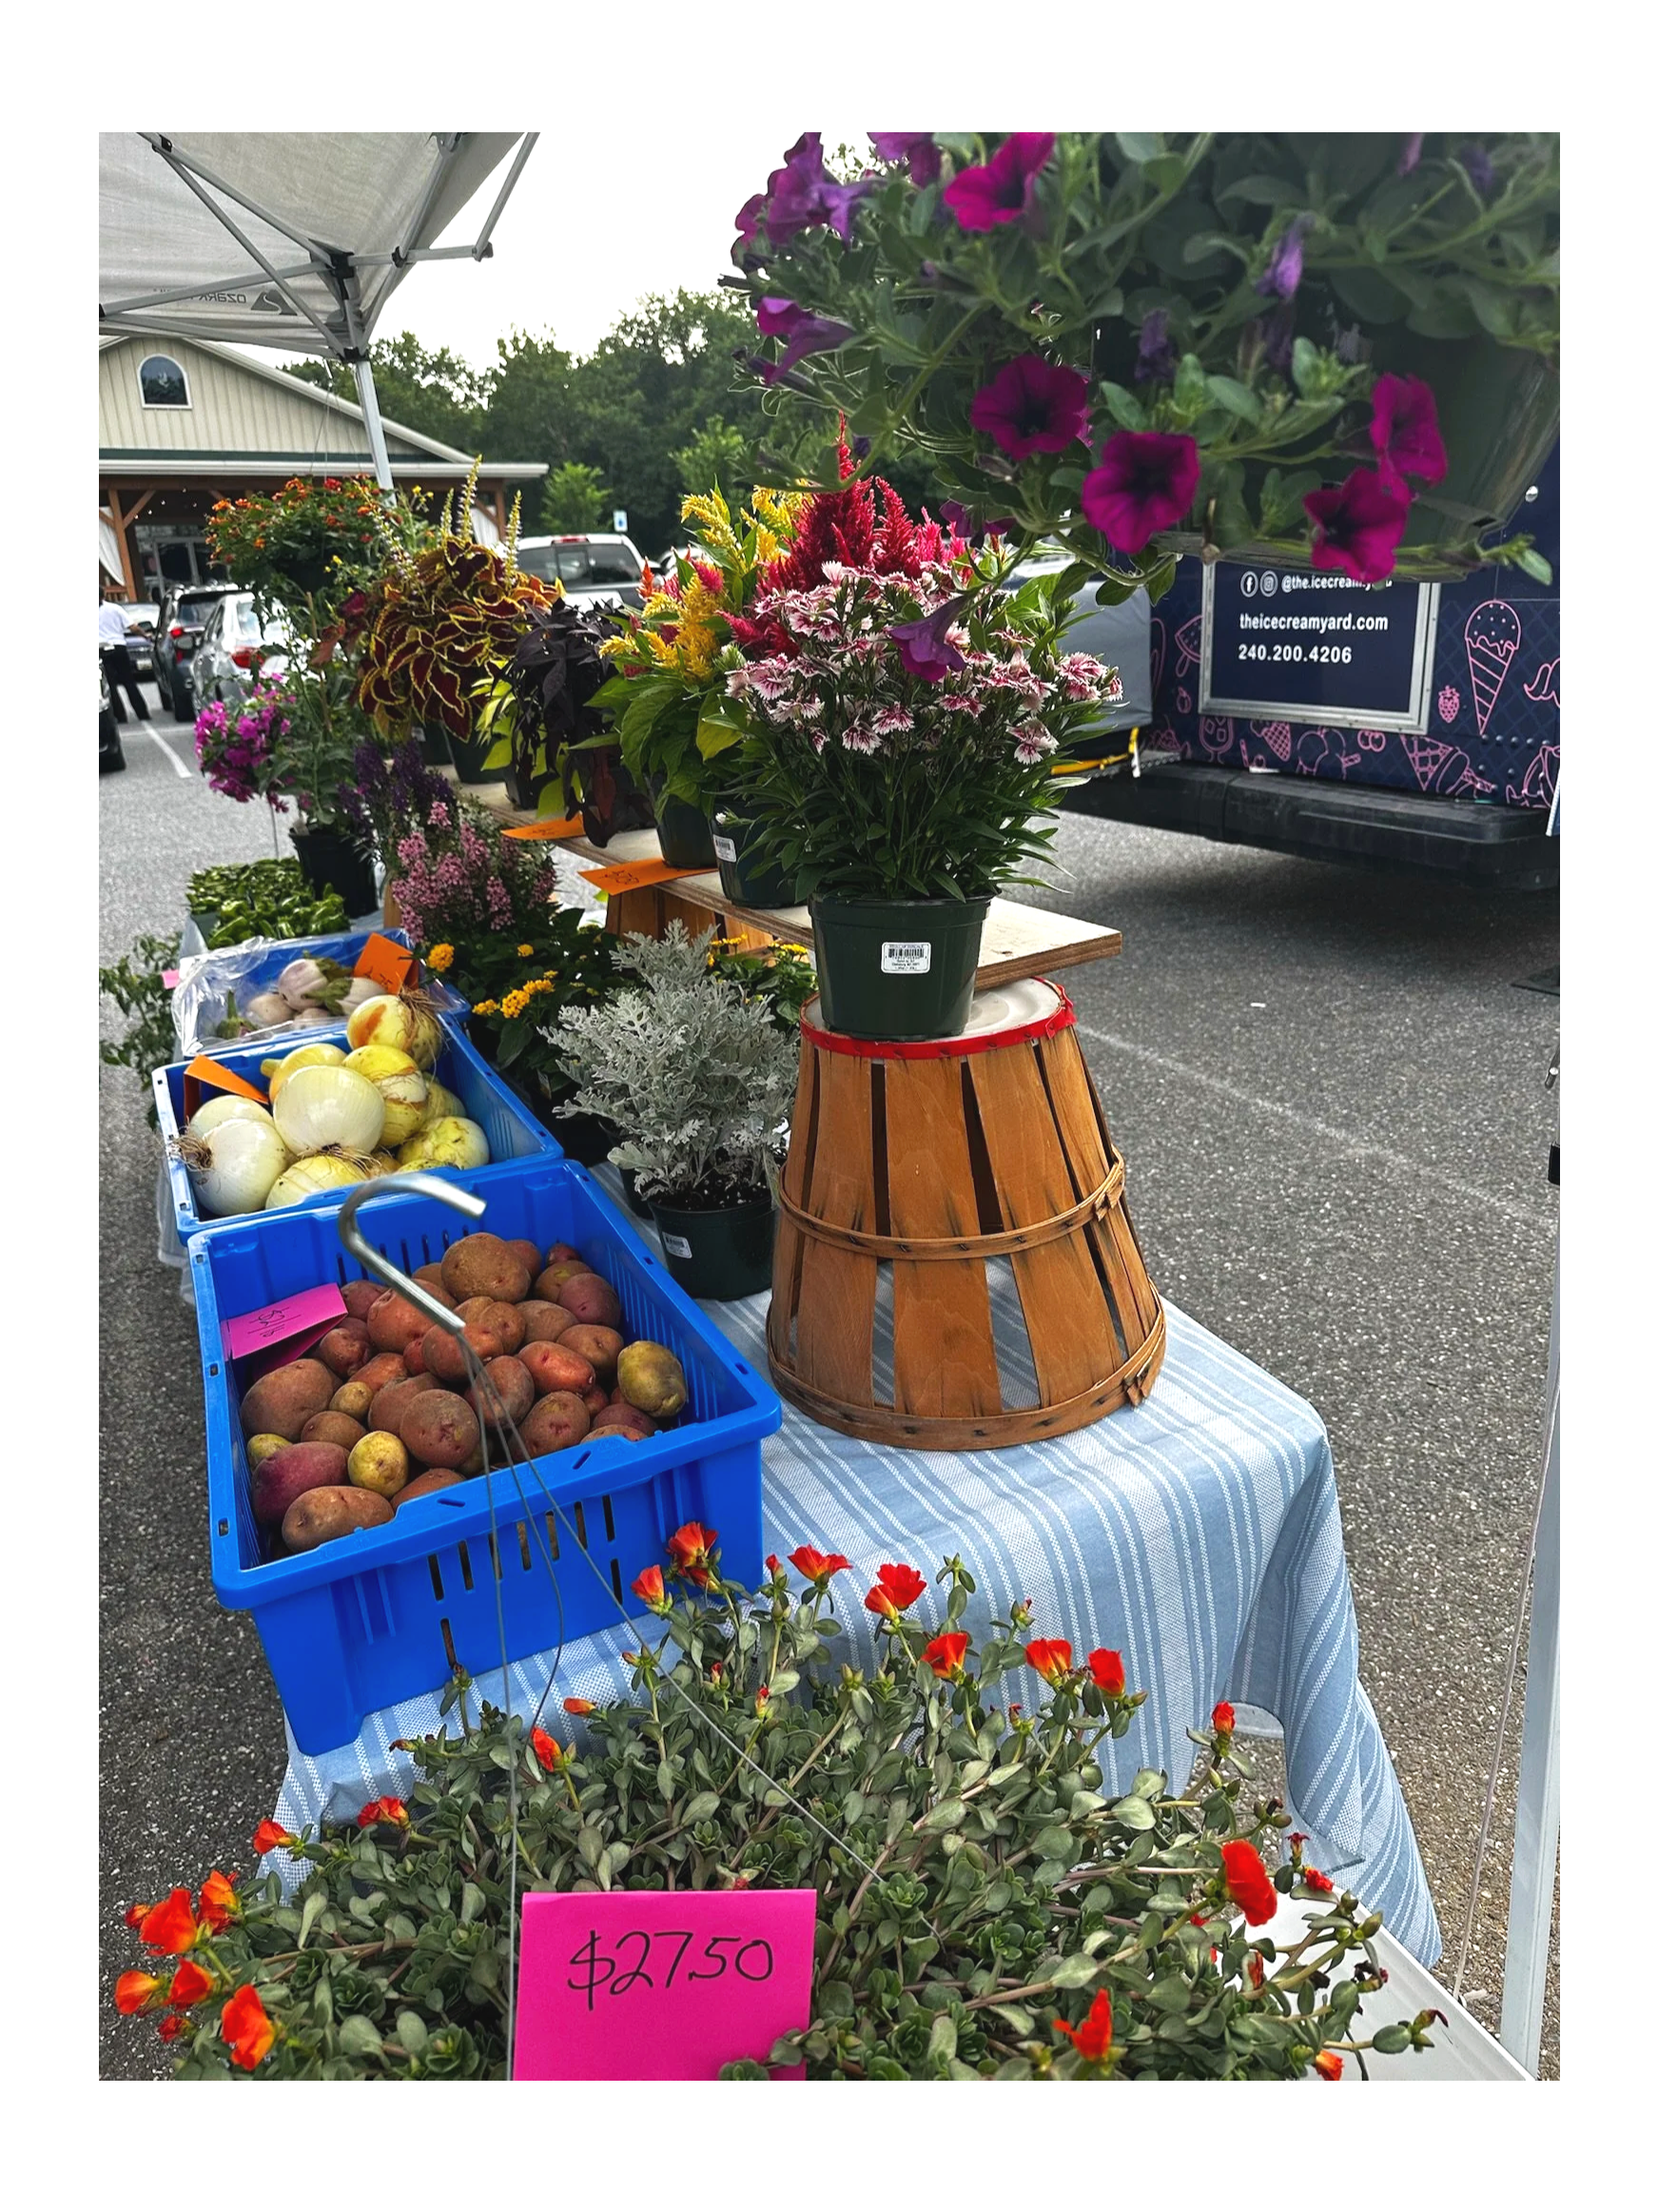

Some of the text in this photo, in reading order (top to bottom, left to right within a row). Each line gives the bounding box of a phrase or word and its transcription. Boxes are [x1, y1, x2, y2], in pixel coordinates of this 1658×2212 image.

[1239, 613, 1389, 634] theicecreamyard.com
[1239, 644, 1352, 663] 240.200.4206
[567, 1929, 773, 2011] $27.50
